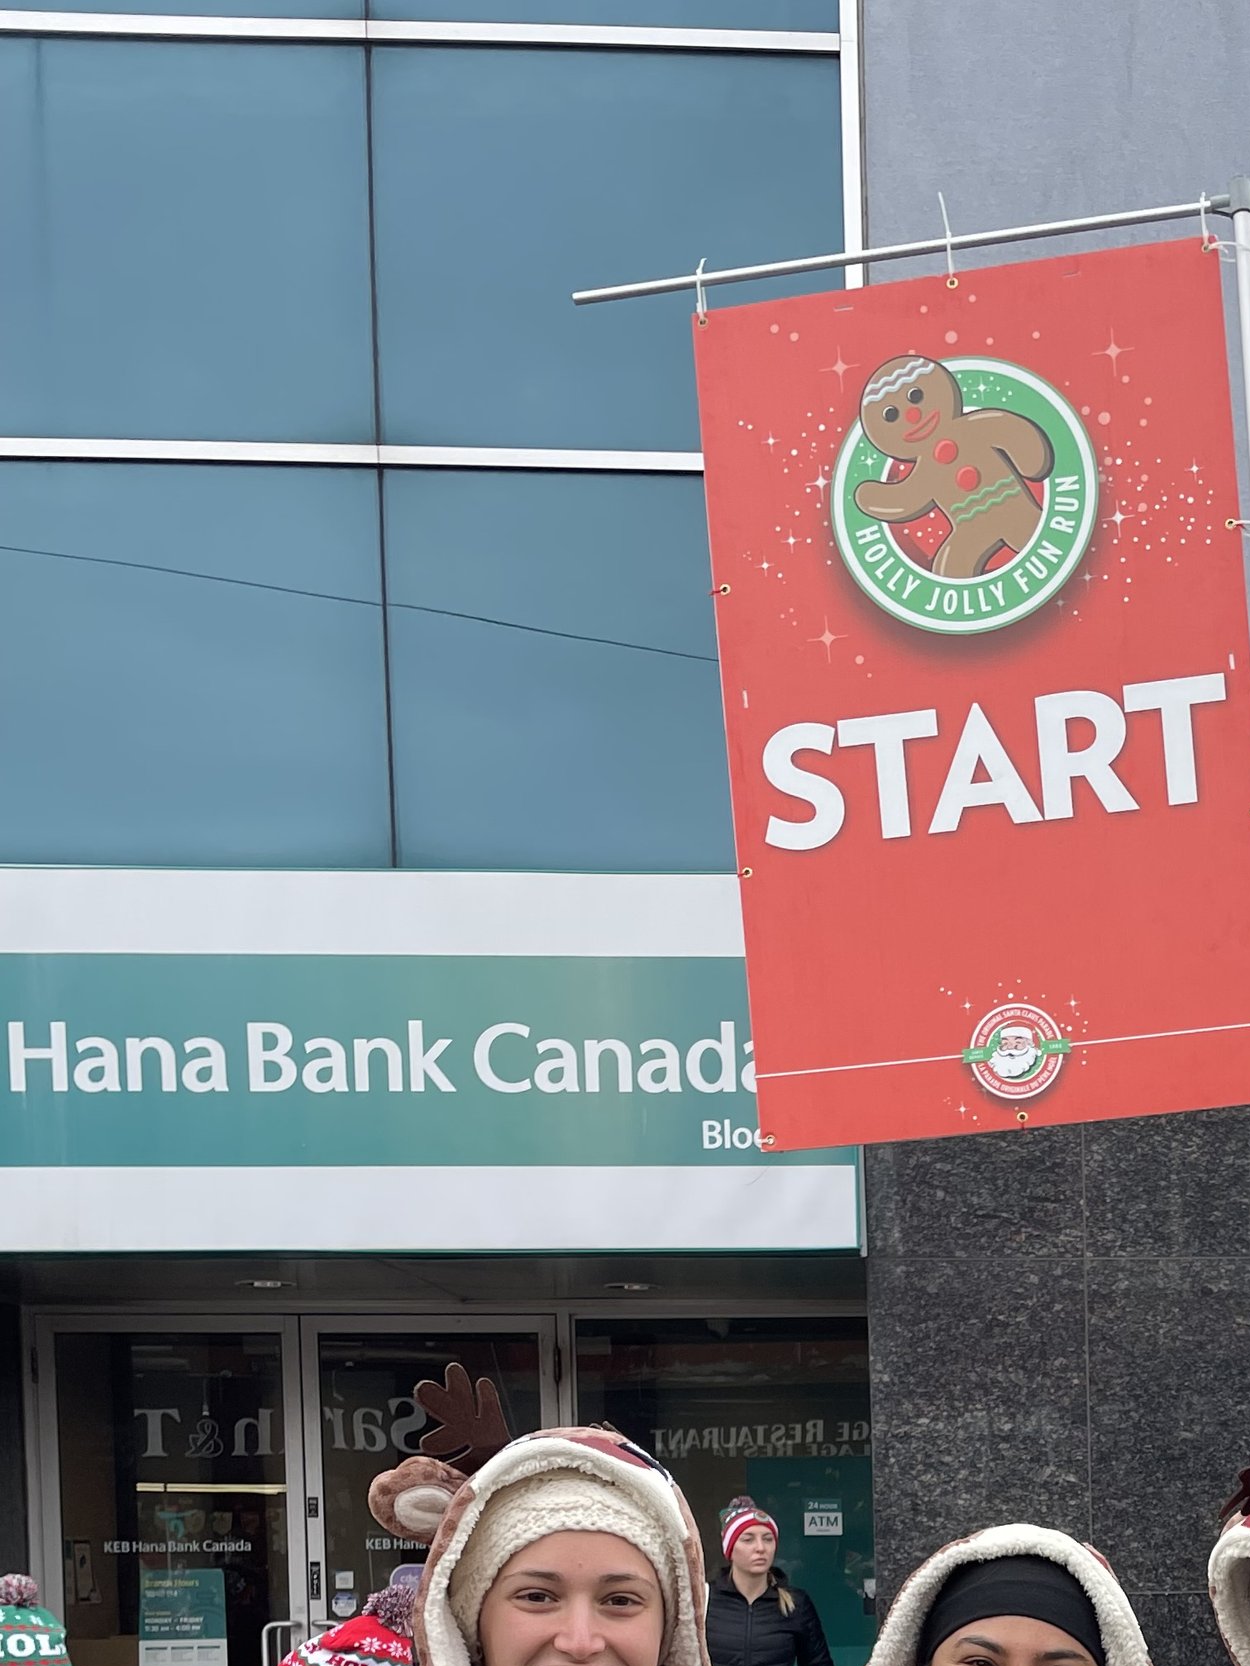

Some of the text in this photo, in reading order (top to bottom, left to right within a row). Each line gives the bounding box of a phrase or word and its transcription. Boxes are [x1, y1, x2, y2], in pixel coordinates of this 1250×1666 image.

[855, 475, 1080, 615] HOLLY JOLLY FUN RUN
[762, 672, 1227, 852] START
[7, 1020, 229, 1093] Hana
[247, 1020, 457, 1093] Bank
[808, 1516, 838, 1527] ATM
[103, 1539, 252, 1553] KEB Hana Bank Canada
[365, 1538, 391, 1550] KEB
